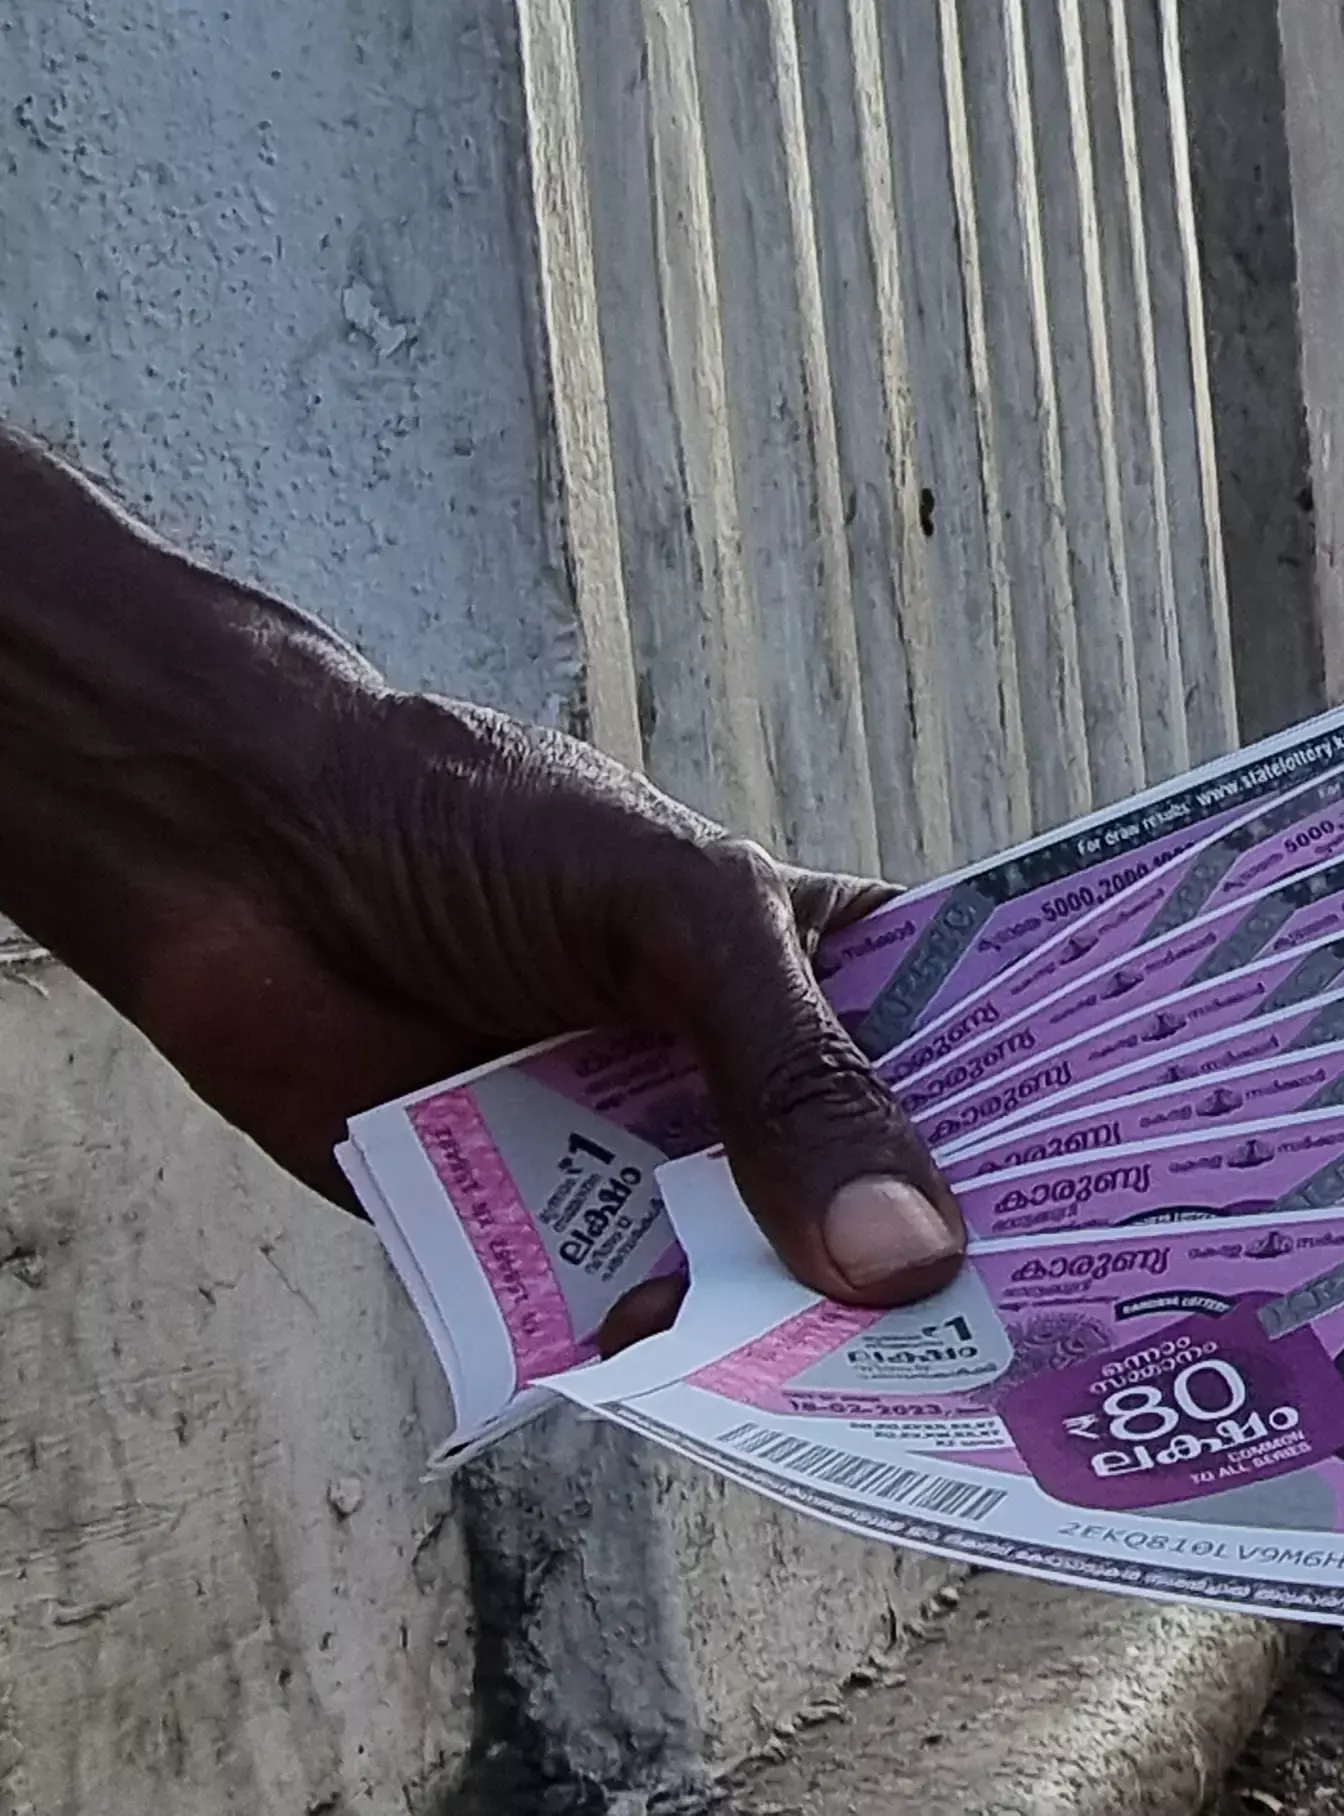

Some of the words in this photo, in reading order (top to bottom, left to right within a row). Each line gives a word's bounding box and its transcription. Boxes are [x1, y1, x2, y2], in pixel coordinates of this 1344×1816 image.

[1317, 777, 1342, 800] For
[1077, 834, 1103, 857] For
[1104, 821, 1142, 846] draw
[993, 1163, 1151, 1214] കാരുണ്യ
[1010, 1247, 1172, 1283] കാരുണ്യ
[1061, 1357, 1247, 1441] ₹80
[1089, 1404, 1300, 1478] ലക്ഷം
[1226, 1430, 1306, 1464] COMMON
[1189, 1472, 1216, 1485] TO
[1218, 1463, 1250, 1481] ALL
[1252, 1443, 1313, 1468] SERIES
